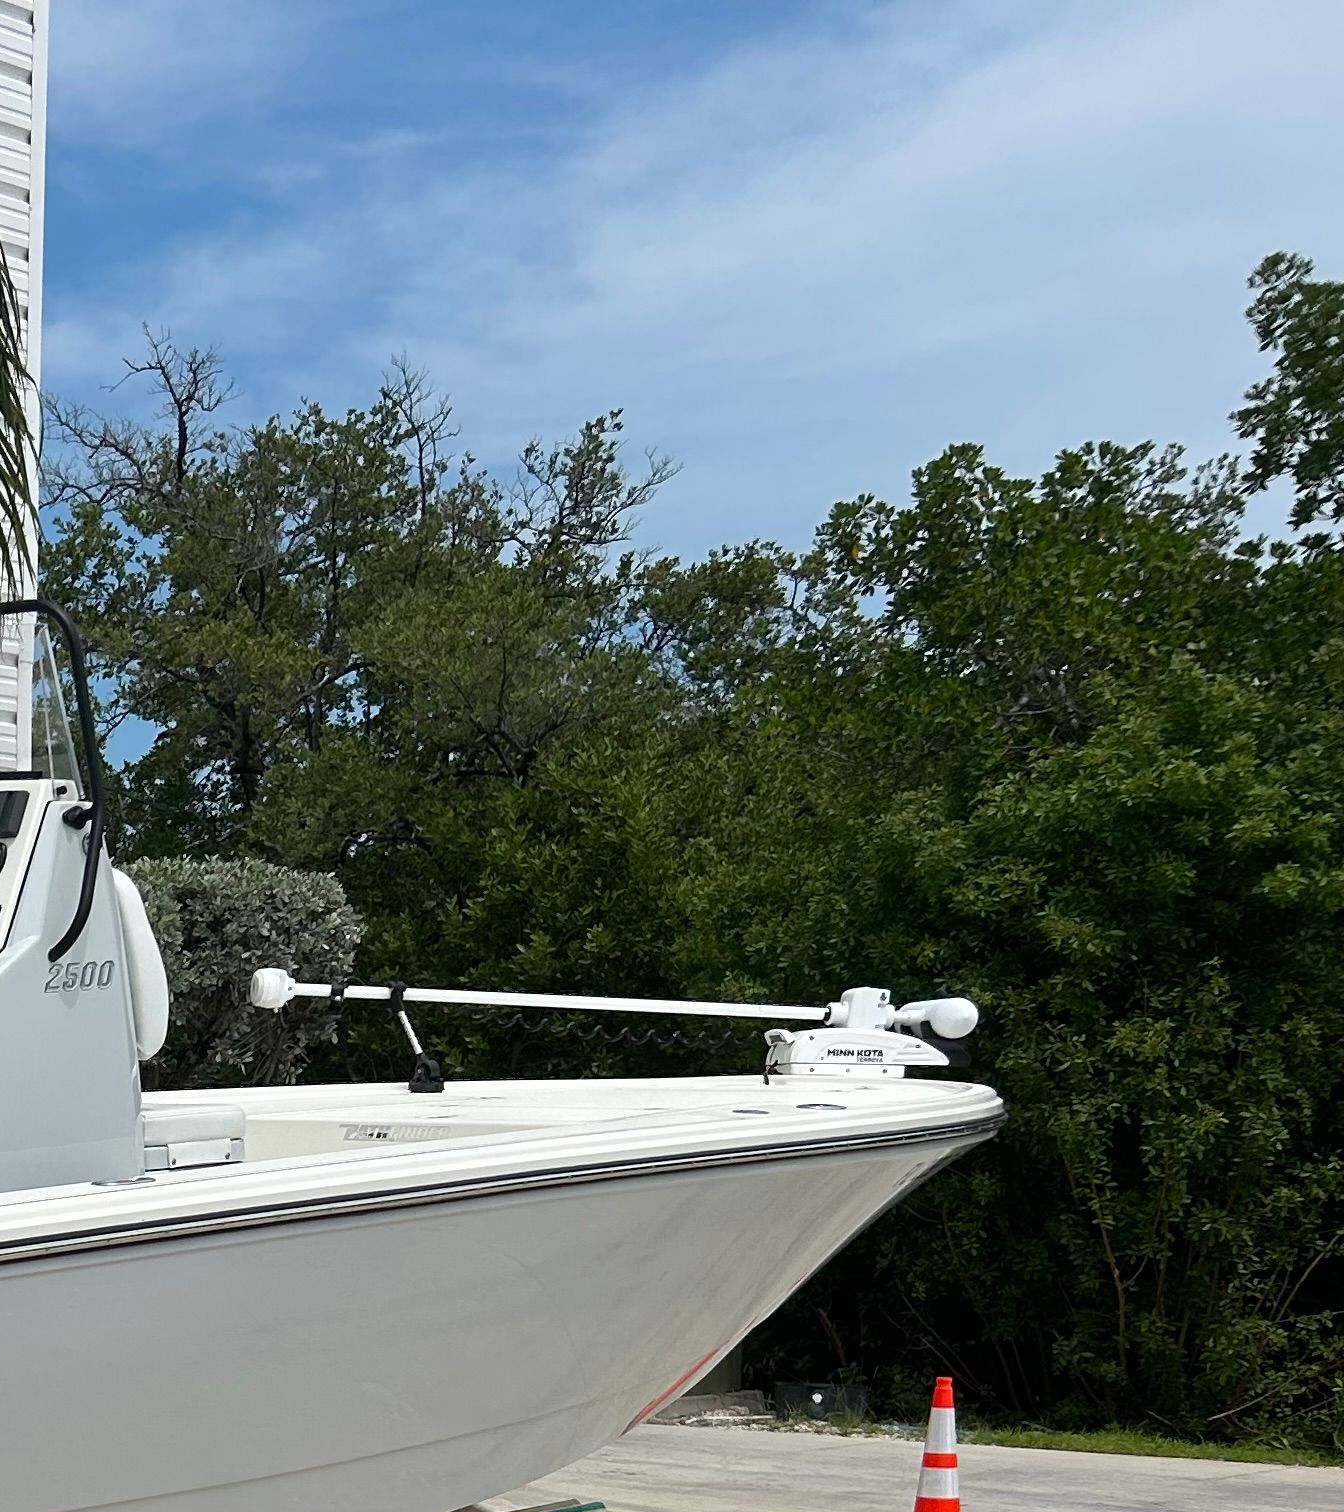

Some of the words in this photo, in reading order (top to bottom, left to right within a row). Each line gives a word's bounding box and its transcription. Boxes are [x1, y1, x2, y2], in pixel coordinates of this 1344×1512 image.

[44, 960, 114, 993] 2500
[827, 1049, 854, 1057] MINN
[857, 1049, 883, 1057] KOTA
